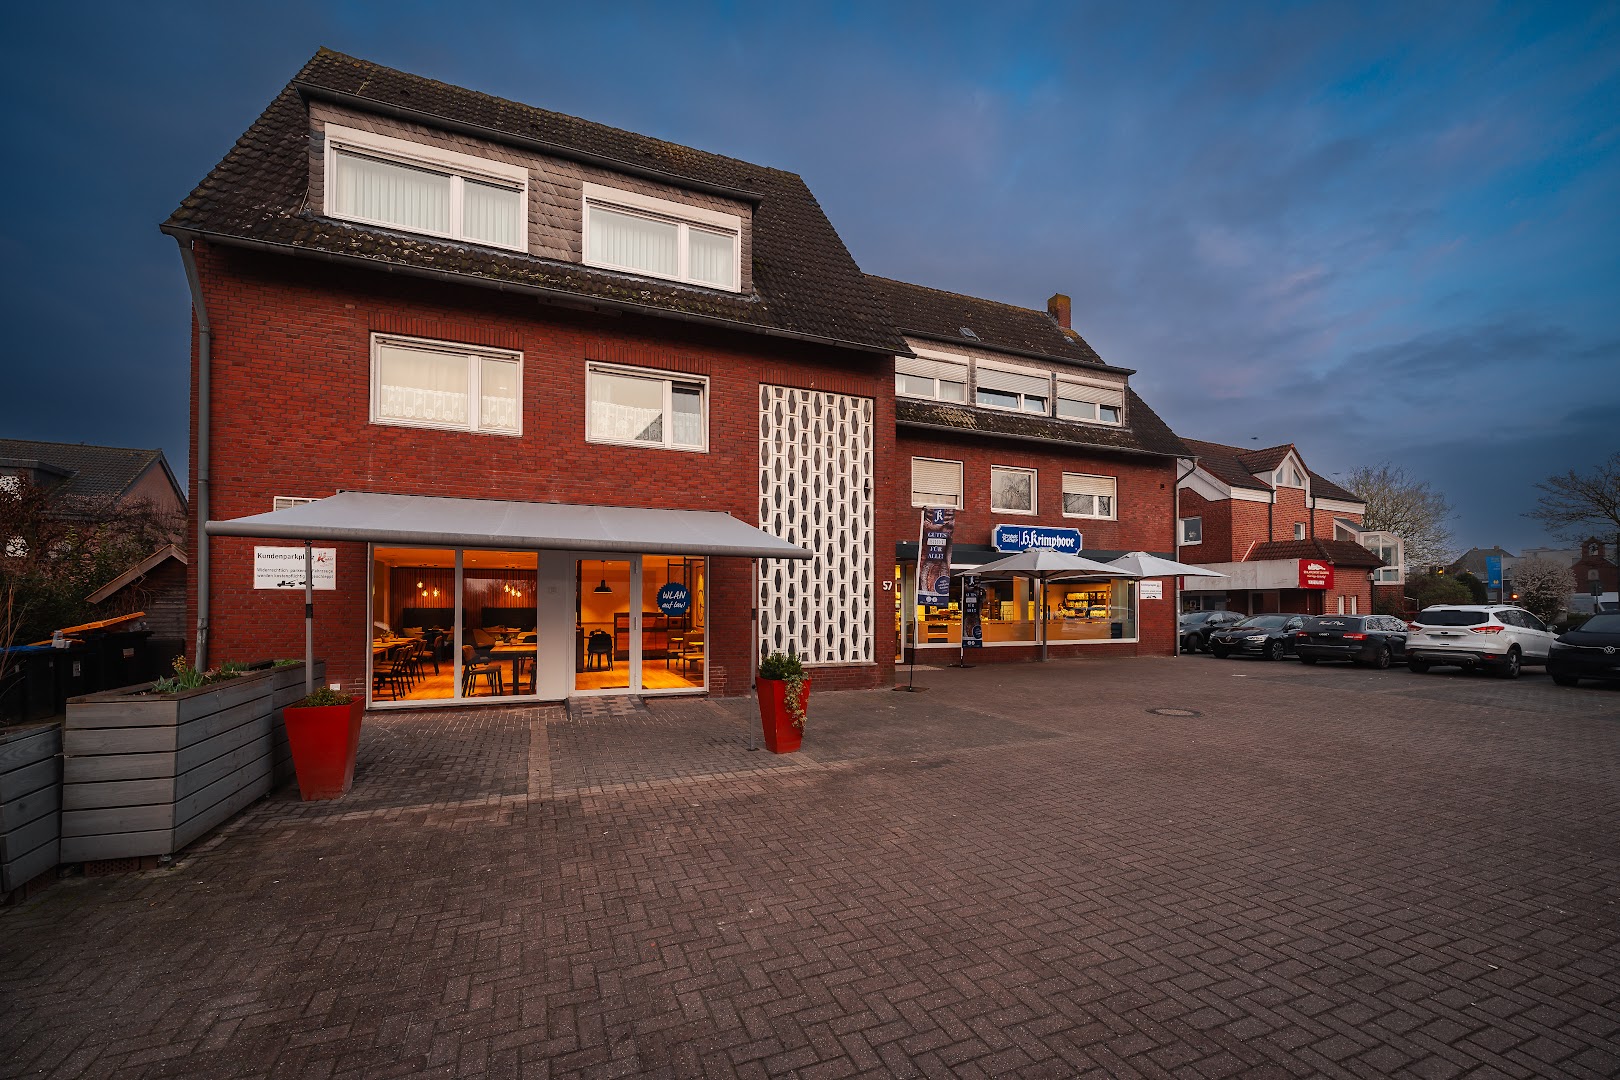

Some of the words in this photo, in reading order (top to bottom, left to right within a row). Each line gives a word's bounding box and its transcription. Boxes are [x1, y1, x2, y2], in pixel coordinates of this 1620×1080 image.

[1028, 530, 1075, 548] Krimphove
[257, 552, 315, 561] Kundenparkplz
[882, 580, 892, 590] 57
[662, 591, 686, 599] WLAN
